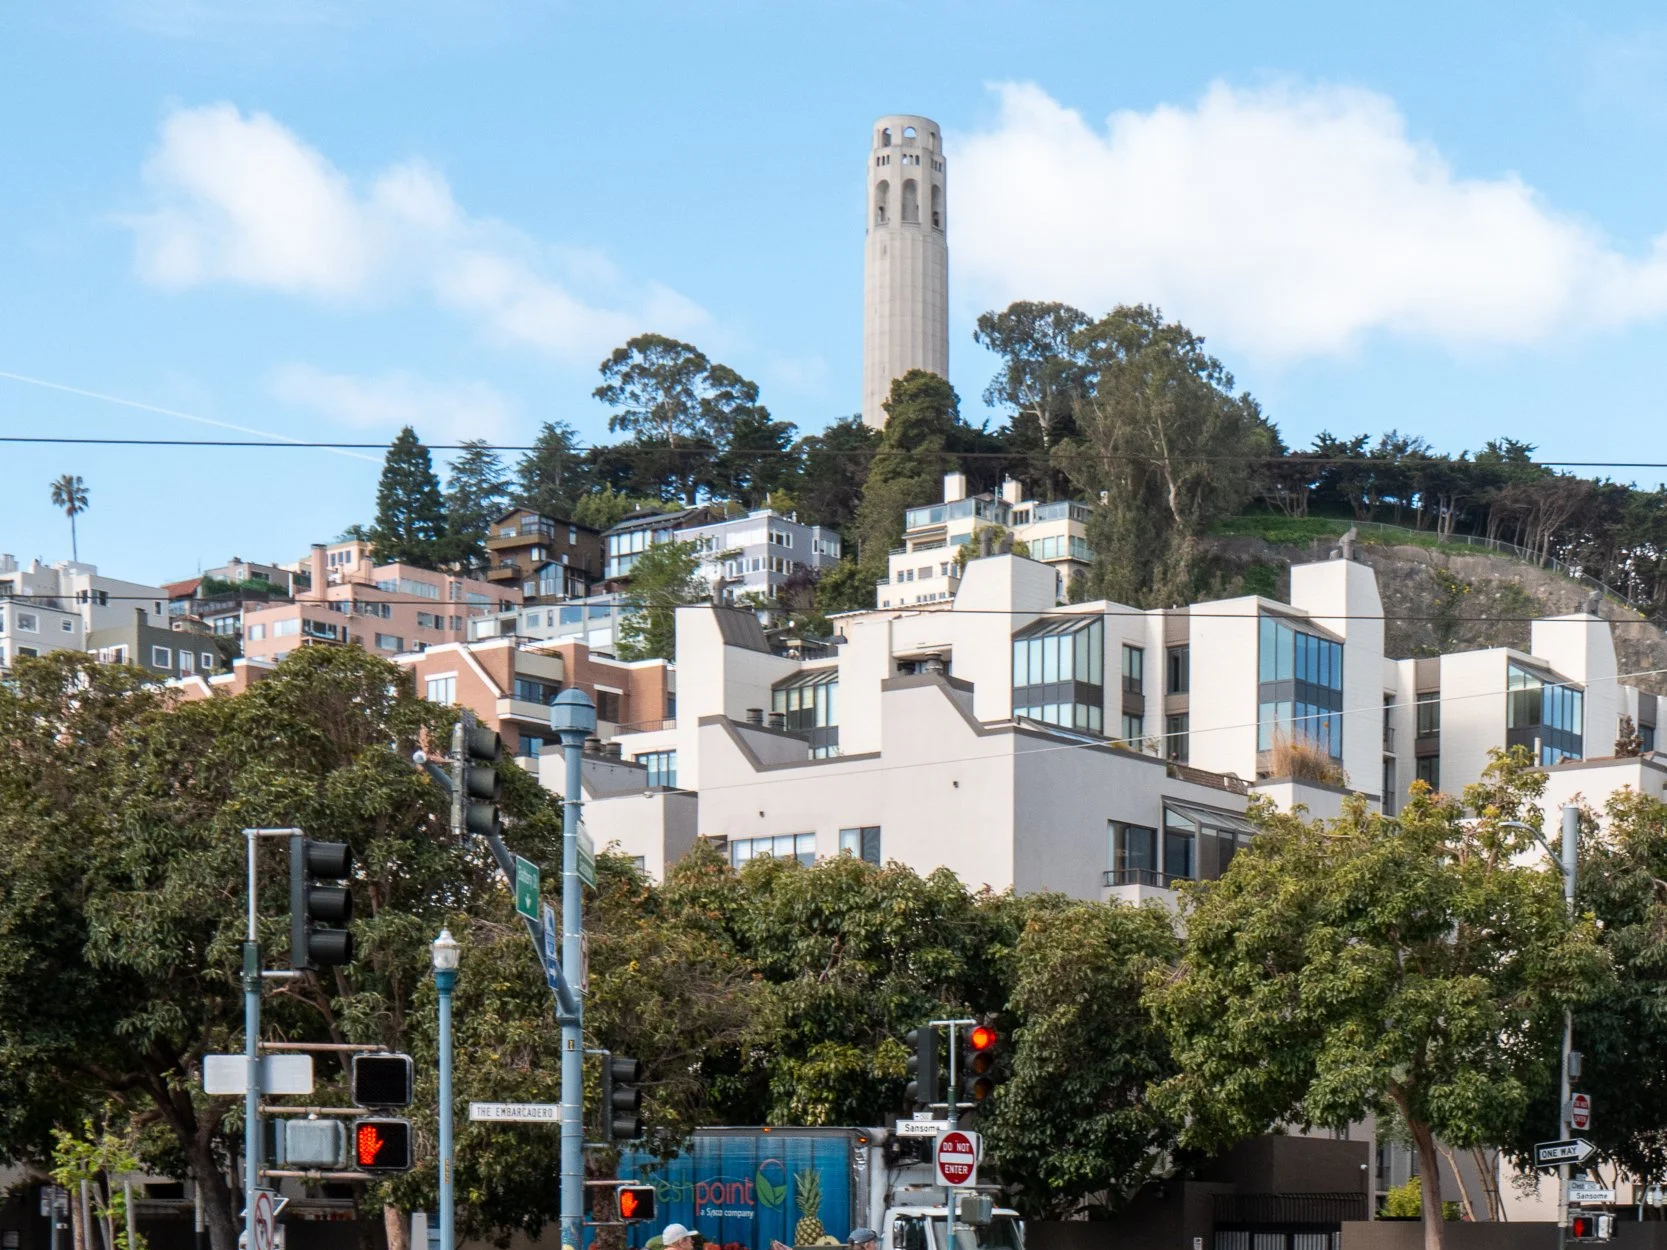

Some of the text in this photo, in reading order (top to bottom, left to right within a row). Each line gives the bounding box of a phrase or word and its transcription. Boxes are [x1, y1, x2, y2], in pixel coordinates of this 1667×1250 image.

[477, 1107, 553, 1118] THE EMBARCADERO
[943, 1142, 970, 1152] DO NOT
[1541, 1146, 1577, 1159] ONE WAY
[944, 1164, 968, 1175] ENTER
[655, 1169, 756, 1216] eshpoint
[1576, 1192, 1608, 1200] Sansome
[724, 1209, 755, 1219] company
